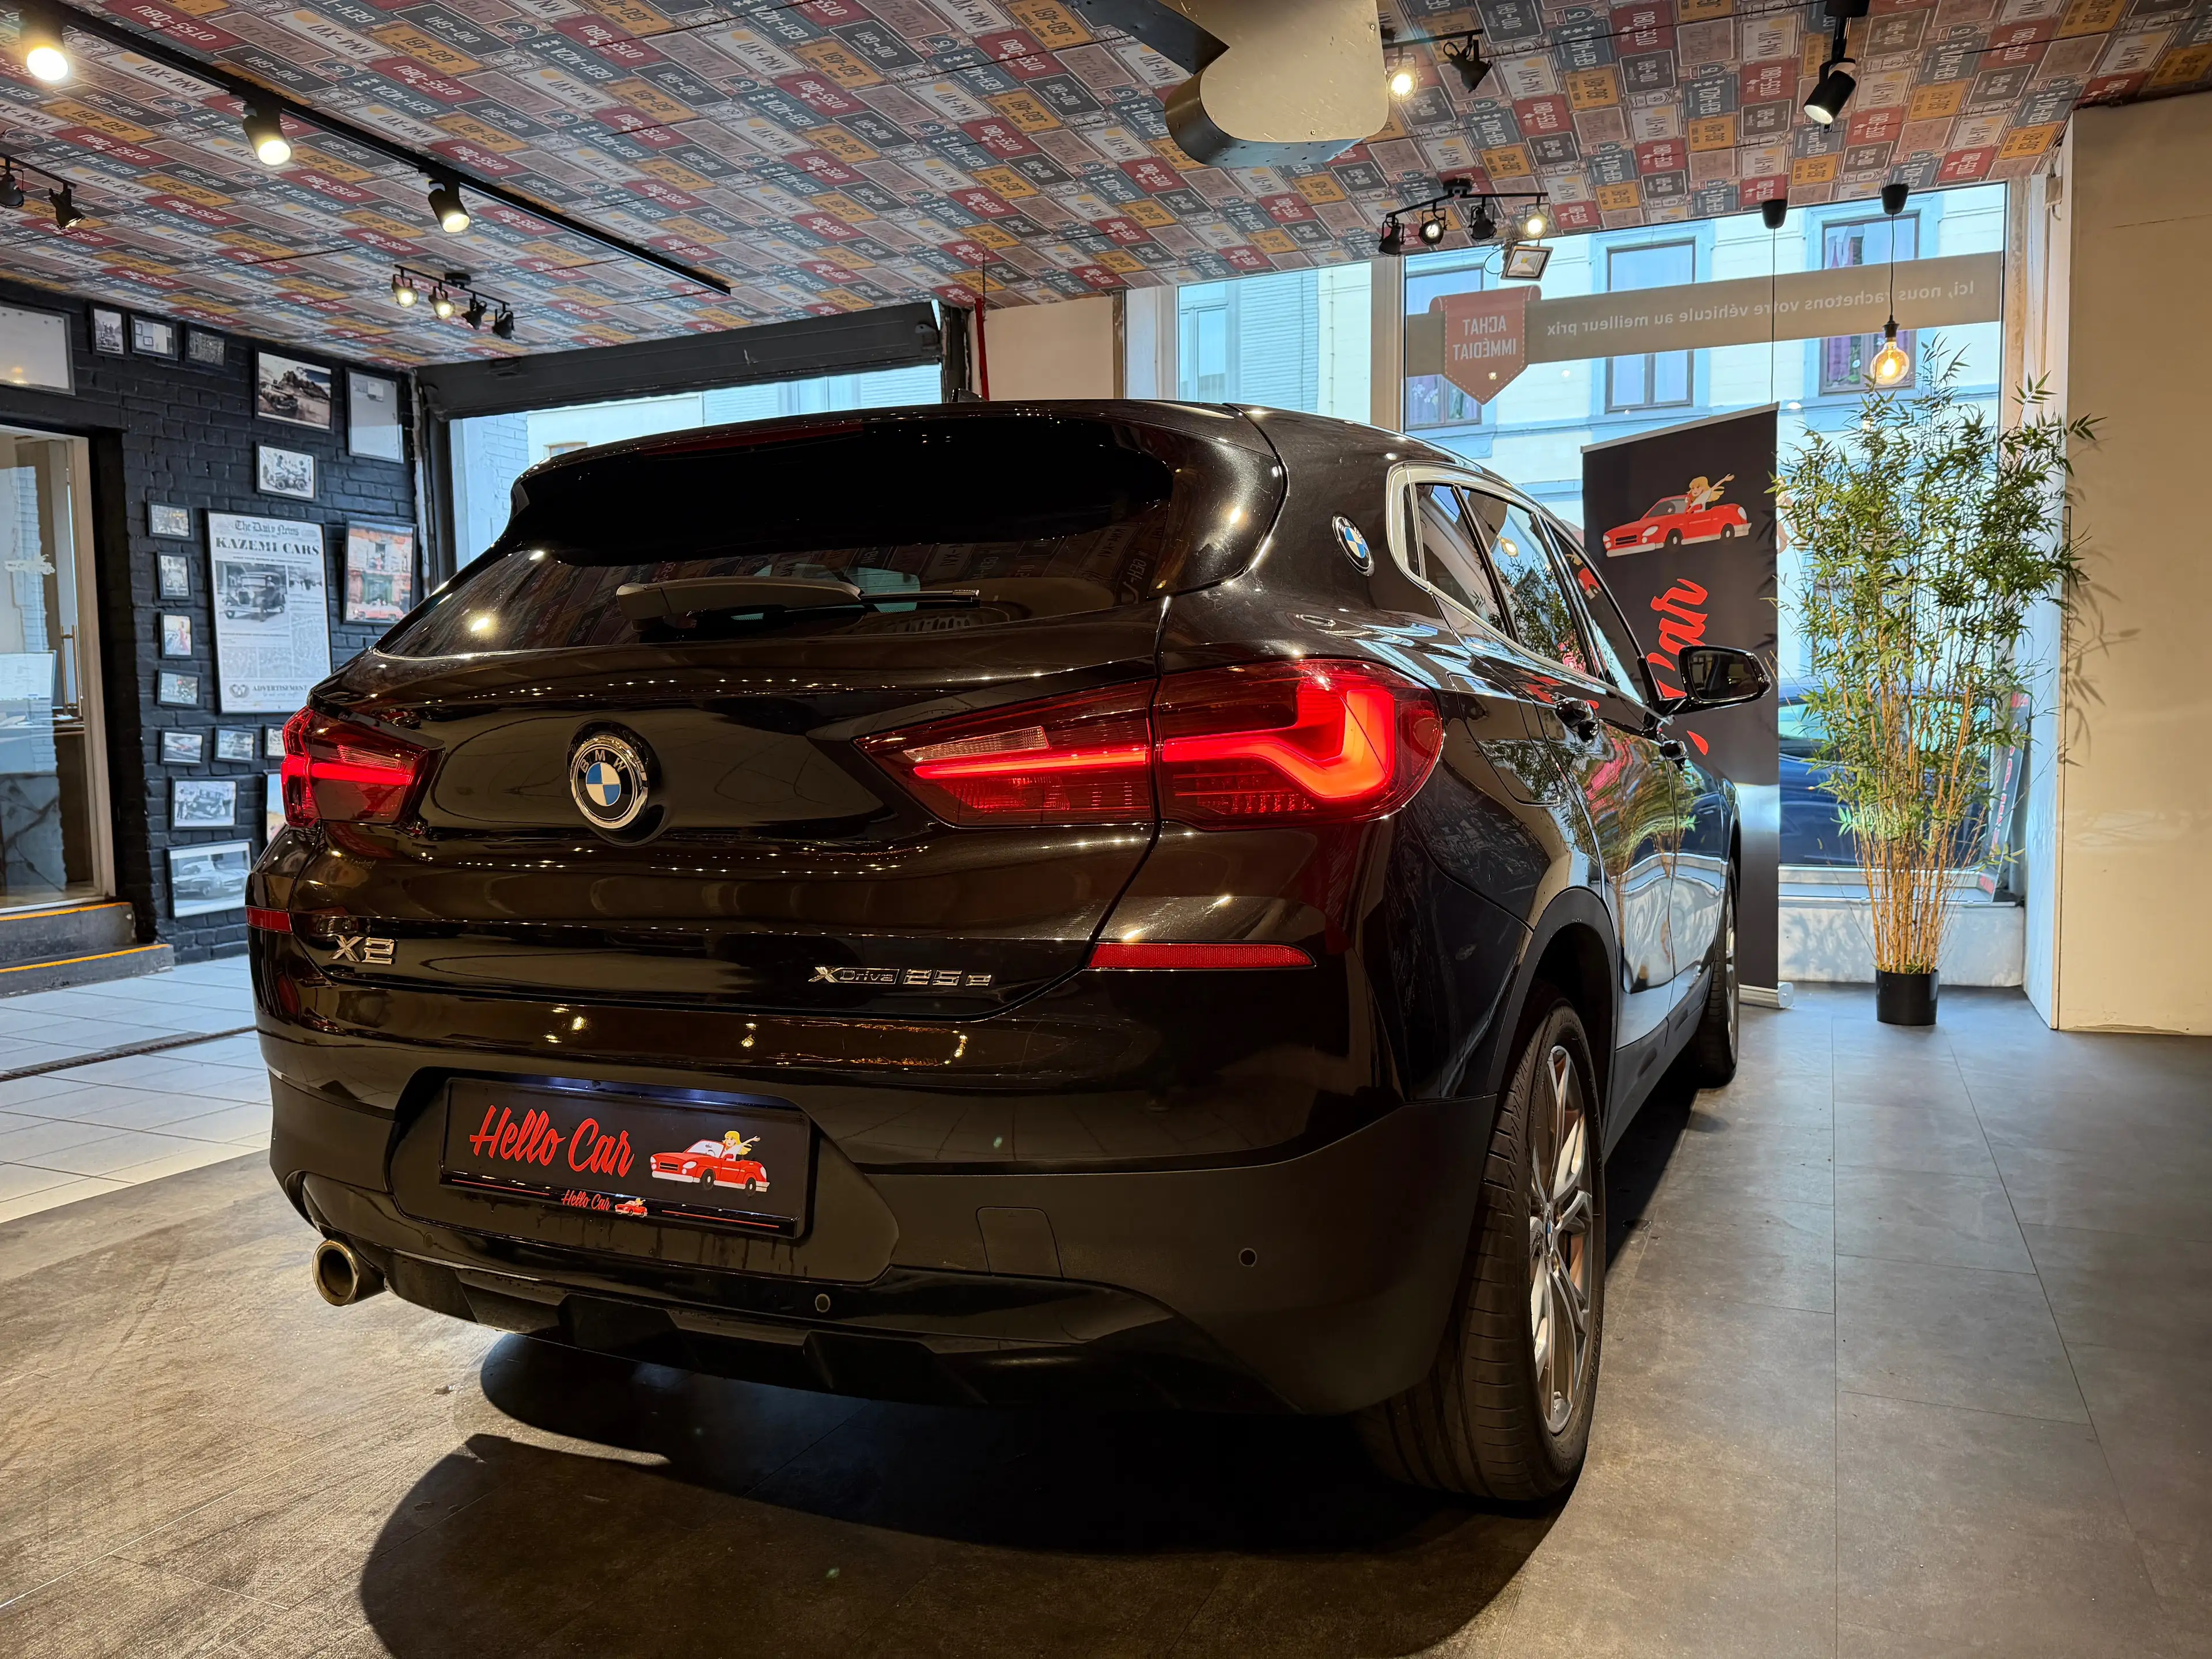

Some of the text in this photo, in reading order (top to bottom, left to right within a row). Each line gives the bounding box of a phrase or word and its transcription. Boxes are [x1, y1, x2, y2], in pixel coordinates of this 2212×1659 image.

[235, 520, 251, 532] The
[276, 524, 299, 536] News
[215, 537, 320, 556] KAZEMI CARS
[579, 749, 627, 773] BMW
[328, 934, 395, 965] X2
[469, 1104, 635, 1177] Hello Car
[561, 1189, 612, 1211] Hello Car
